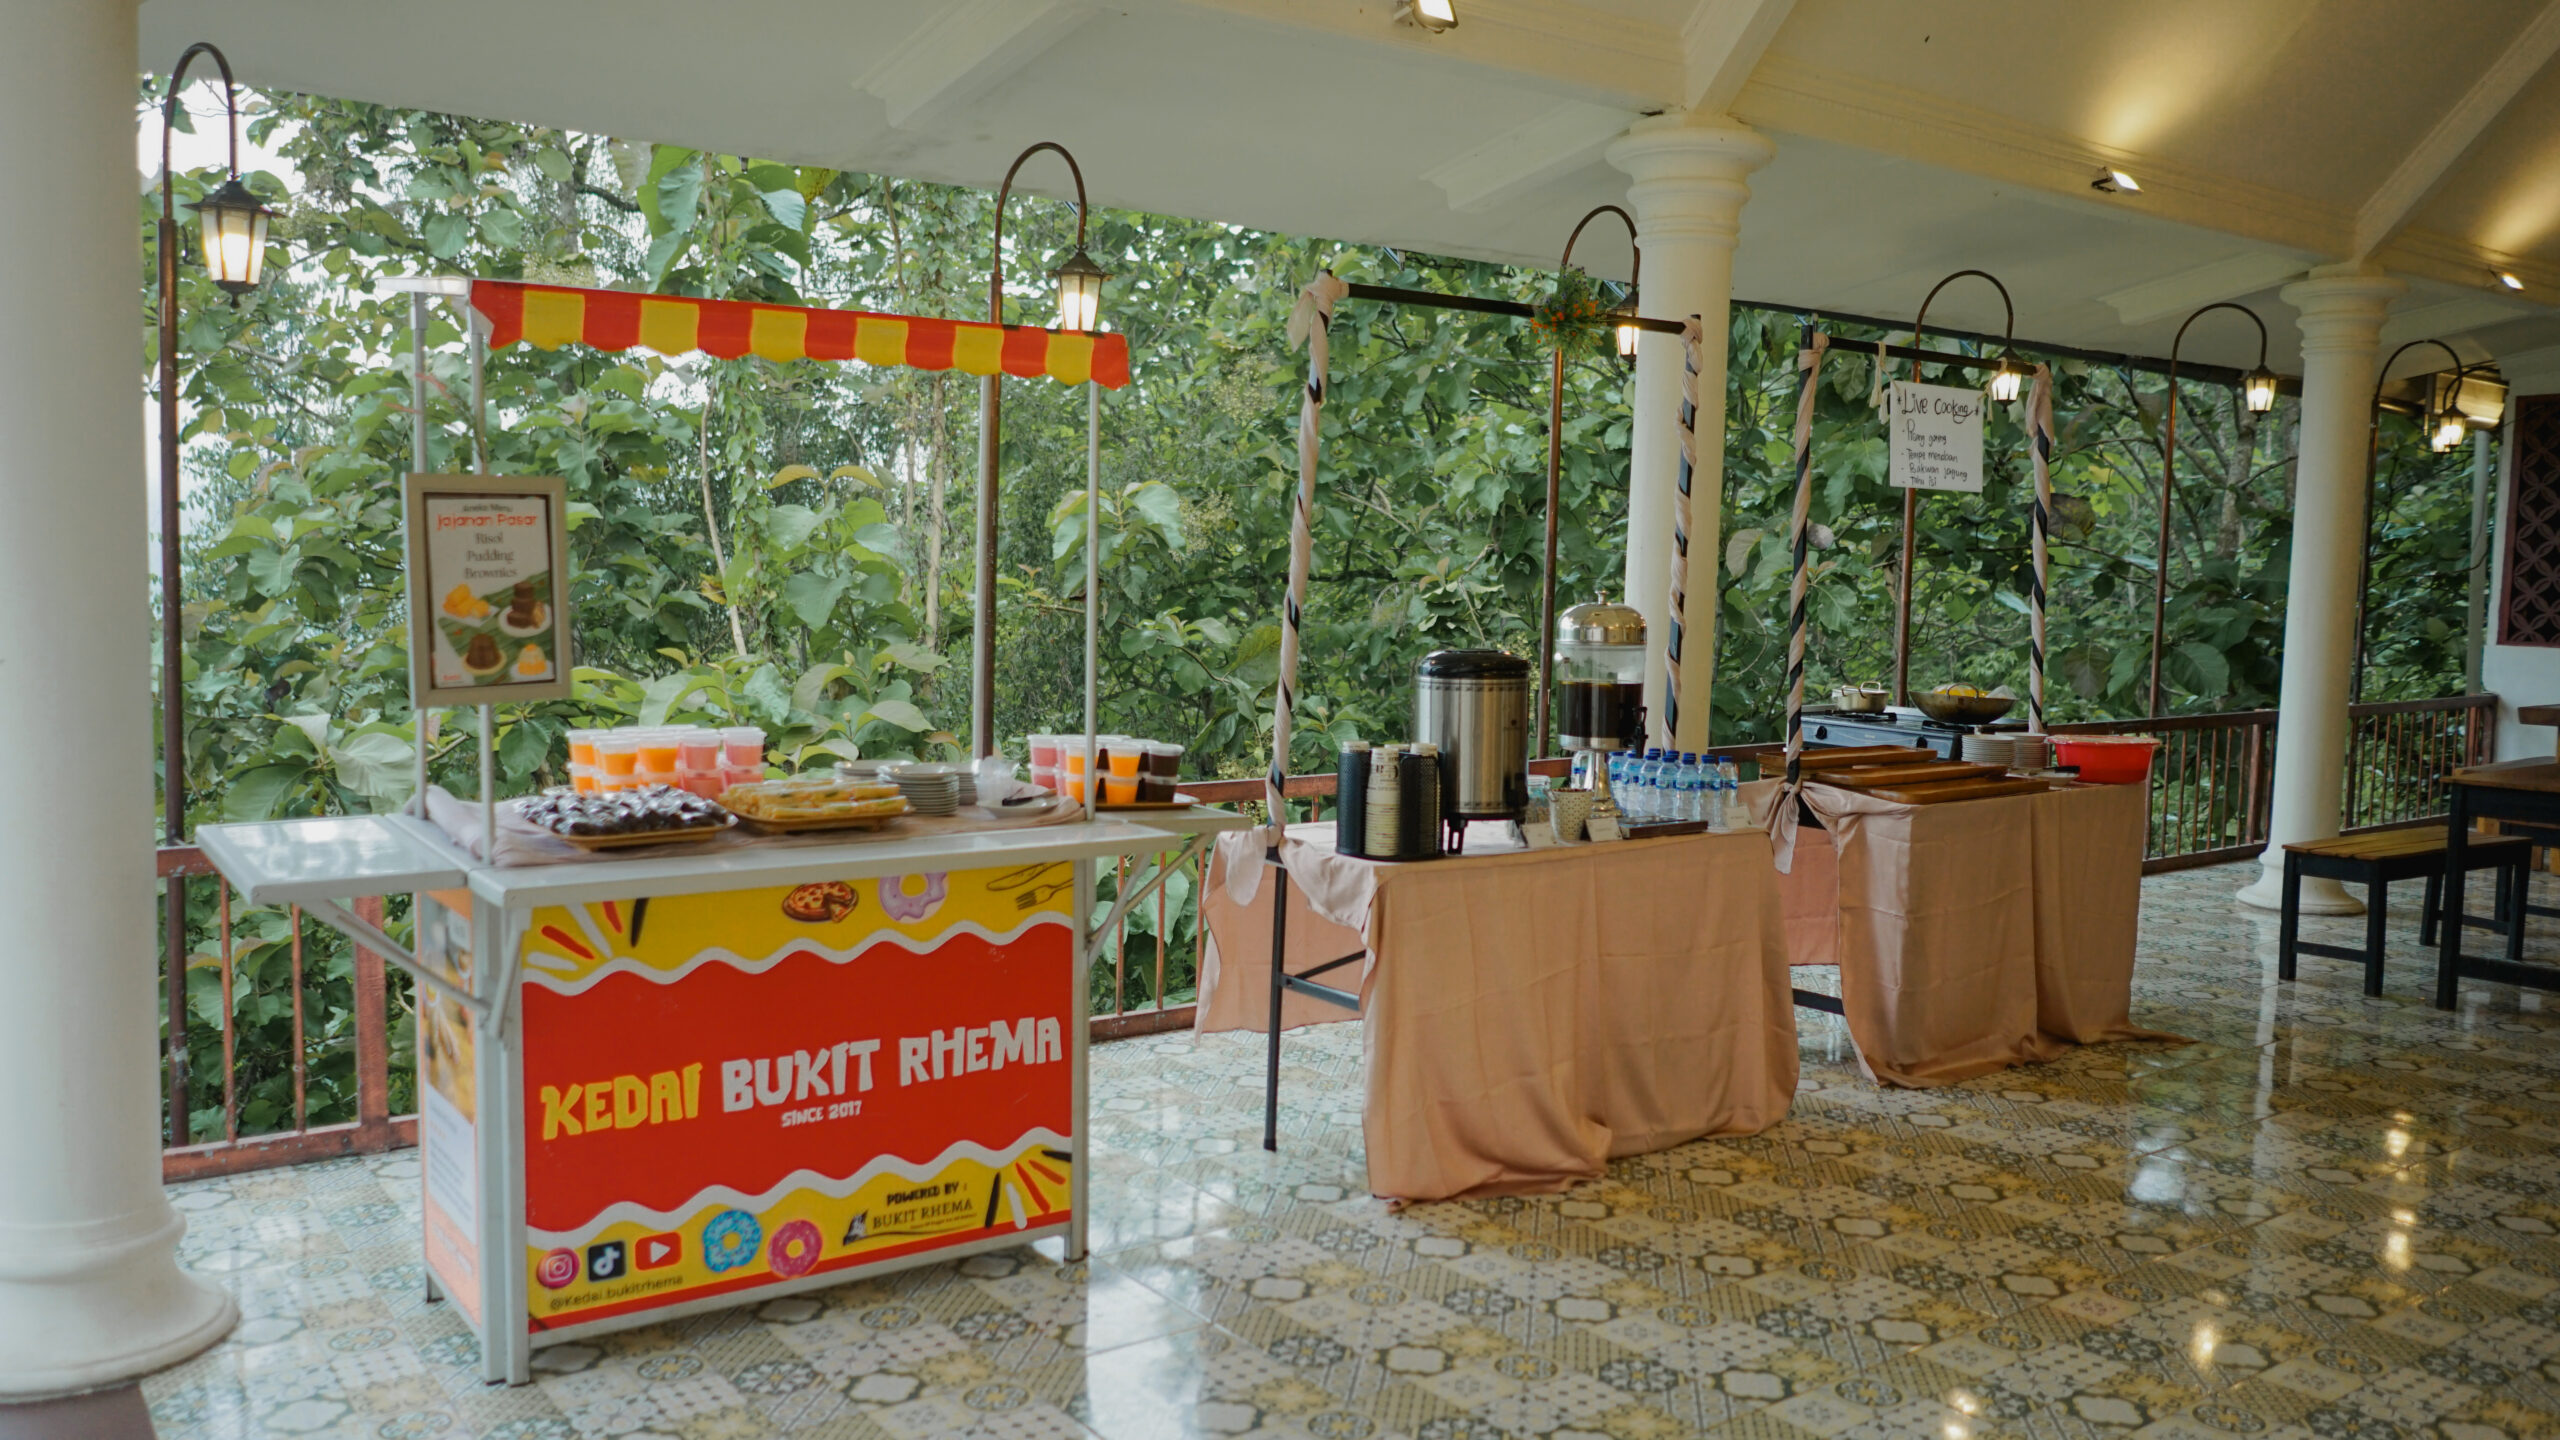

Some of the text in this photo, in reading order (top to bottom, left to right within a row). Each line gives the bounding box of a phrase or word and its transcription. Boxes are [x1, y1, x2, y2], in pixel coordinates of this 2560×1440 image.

[1902, 388, 1973, 424] Live Cooking
[497, 513, 537, 526] Pasar
[475, 531, 504, 544] Risol
[466, 549, 514, 565] Pudding
[464, 567, 518, 579] Brownies
[540, 1016, 1063, 1141] KEDAI BUKIT RHEMA
[781, 1100, 862, 1128] SINCE 2017
[886, 1184, 940, 1206] POWERED
[944, 1181, 960, 1195] BY
[872, 1208, 918, 1229] BUKIT
[921, 1197, 973, 1219] RHEMA
